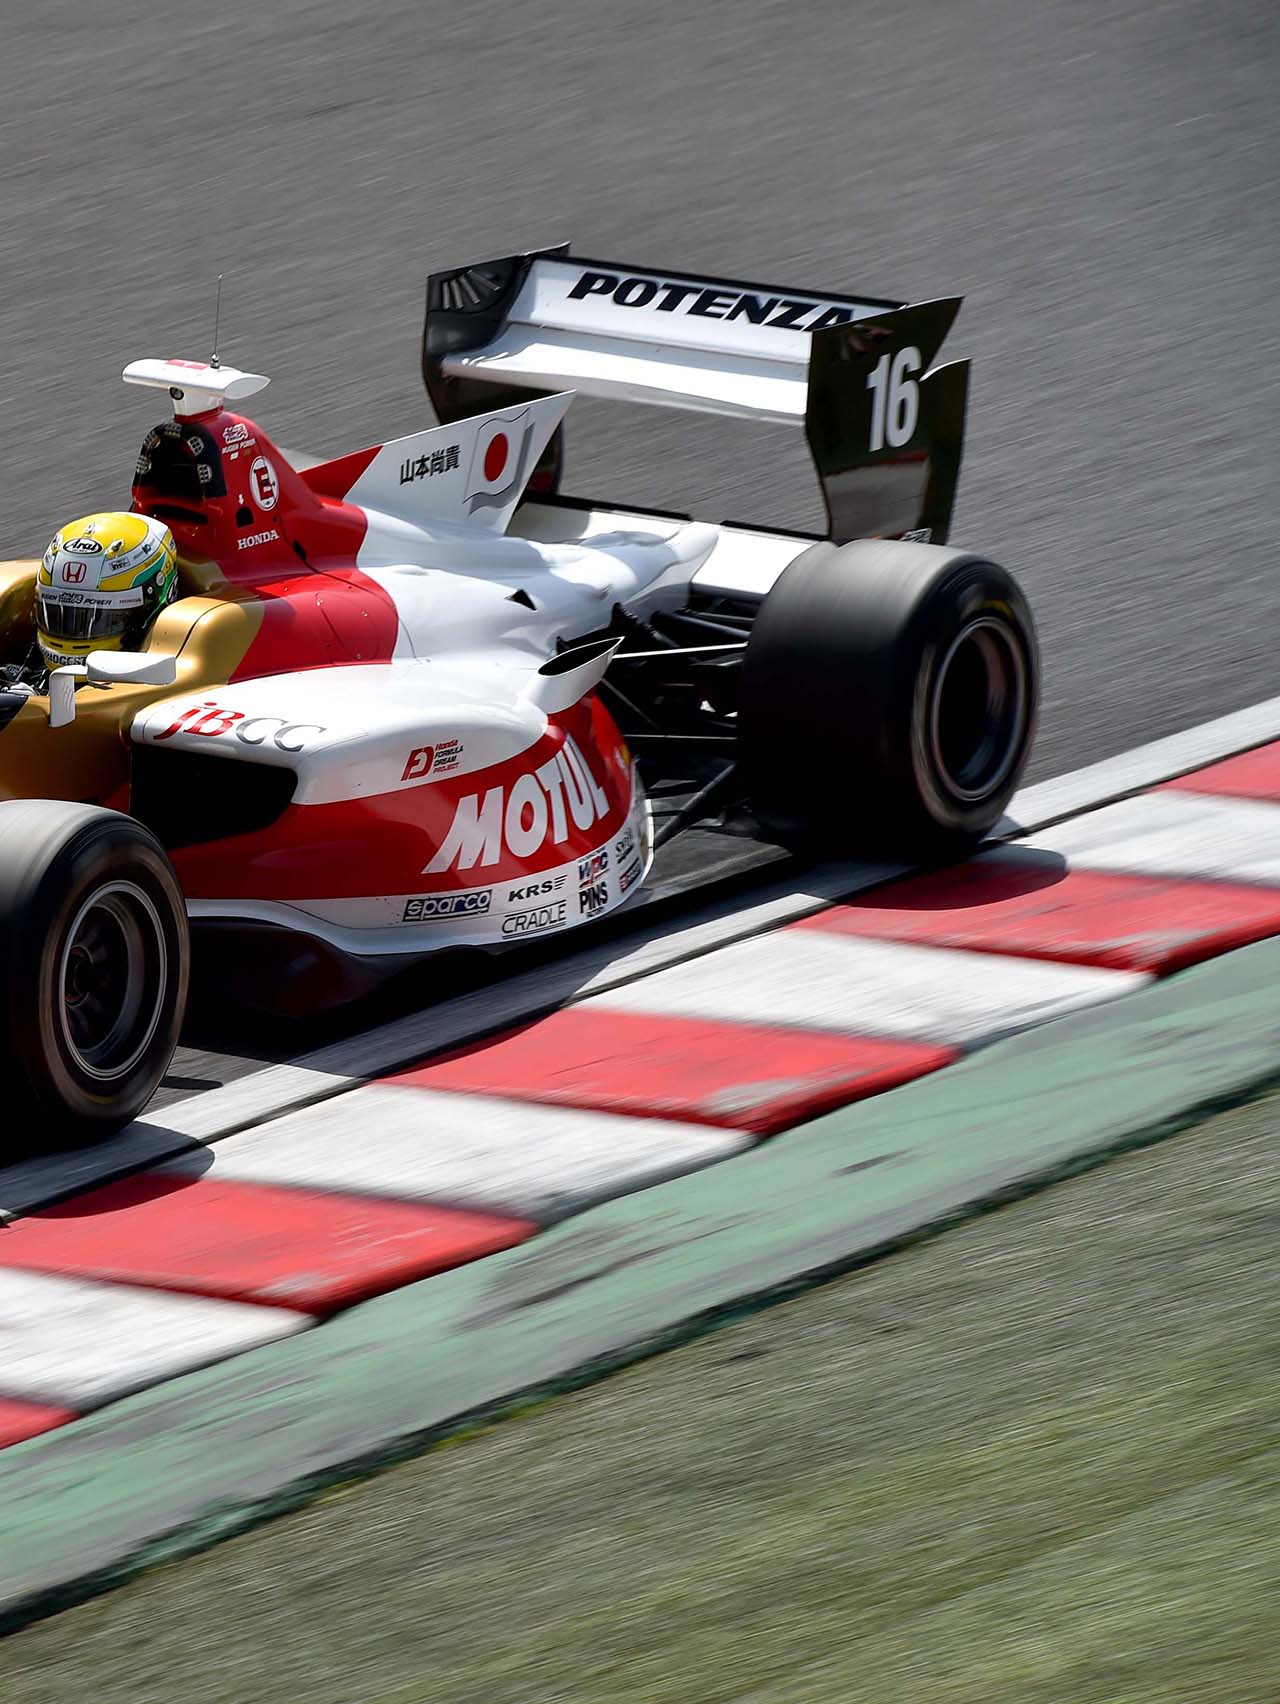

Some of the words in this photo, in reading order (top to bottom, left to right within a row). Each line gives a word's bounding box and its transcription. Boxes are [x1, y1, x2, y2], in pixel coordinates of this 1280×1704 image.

[567, 271, 855, 331] POTENZA
[867, 346, 921, 452] 16
[400, 445, 460, 485] 山本尚貴
[64, 538, 99, 551] Arai
[237, 530, 279, 550] HONDA
[421, 733, 610, 874] MOTUL
[405, 887, 491, 921] sparco
[508, 880, 553, 902] KRS
[579, 881, 608, 914] PINS
[501, 903, 566, 934] CRADLE
